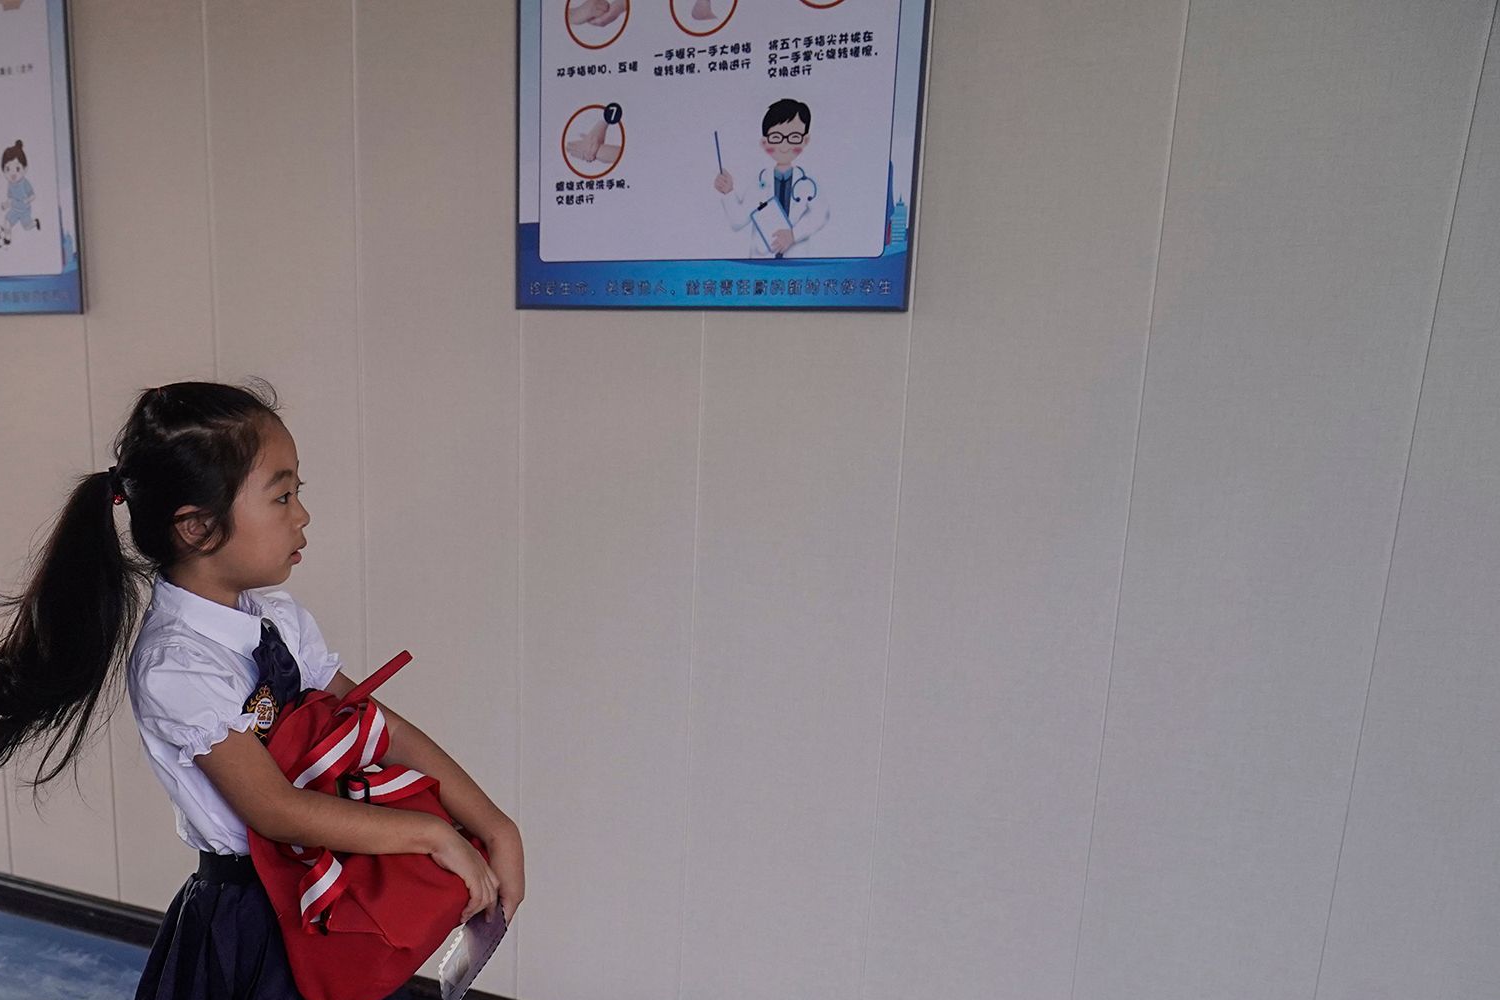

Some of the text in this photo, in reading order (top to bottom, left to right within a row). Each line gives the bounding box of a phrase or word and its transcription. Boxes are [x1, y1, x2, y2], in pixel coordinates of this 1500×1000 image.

[767, 30, 874, 52] 将五个手指尖并拢在
[653, 41, 752, 61] 一手握另一手大拇指
[767, 64, 814, 79] 交换进行
[608, 106, 618, 121] 7
[555, 193, 595, 206] 交替进行
